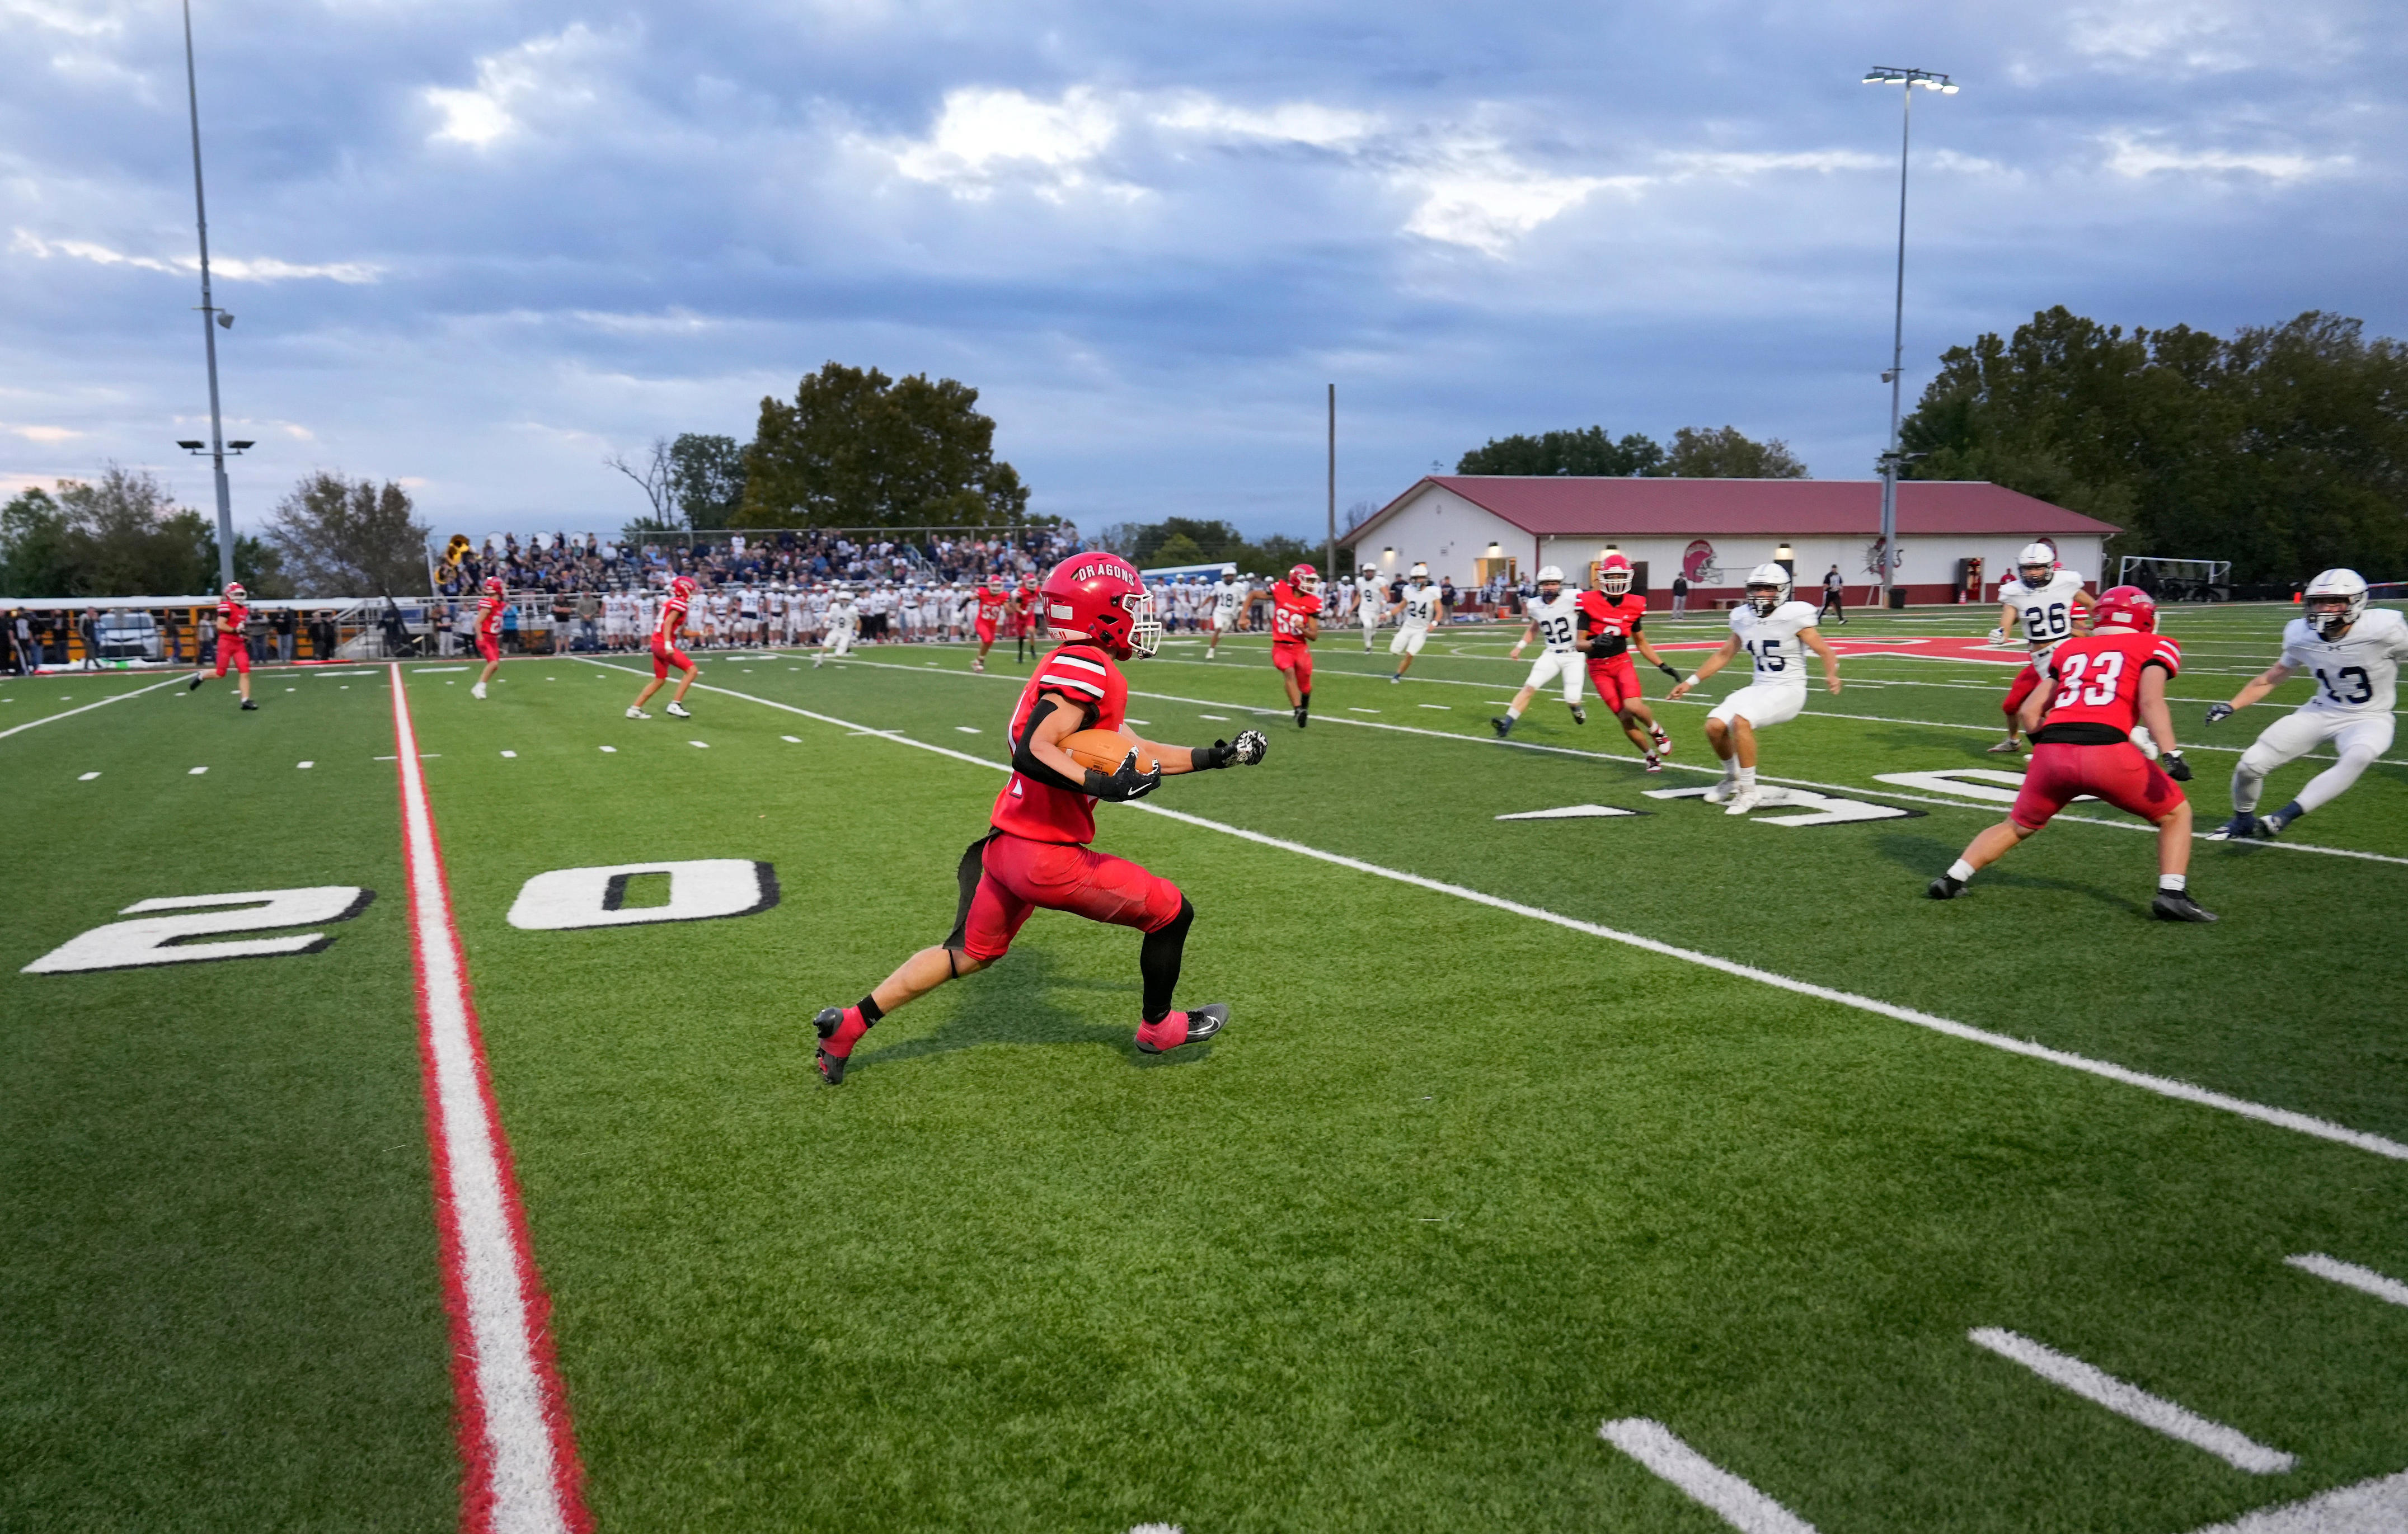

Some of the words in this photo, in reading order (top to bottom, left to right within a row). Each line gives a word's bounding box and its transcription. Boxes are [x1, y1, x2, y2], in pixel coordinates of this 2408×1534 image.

[1078, 563, 1136, 587] DRAGONS
[1220, 593, 1233, 608] 18
[1409, 600, 1427, 619] 24
[1541, 617, 1572, 644] 22
[2025, 603, 2066, 637] 26
[1747, 639, 1786, 672] 15
[2054, 650, 2125, 706] 33
[2316, 666, 2373, 704] 13
